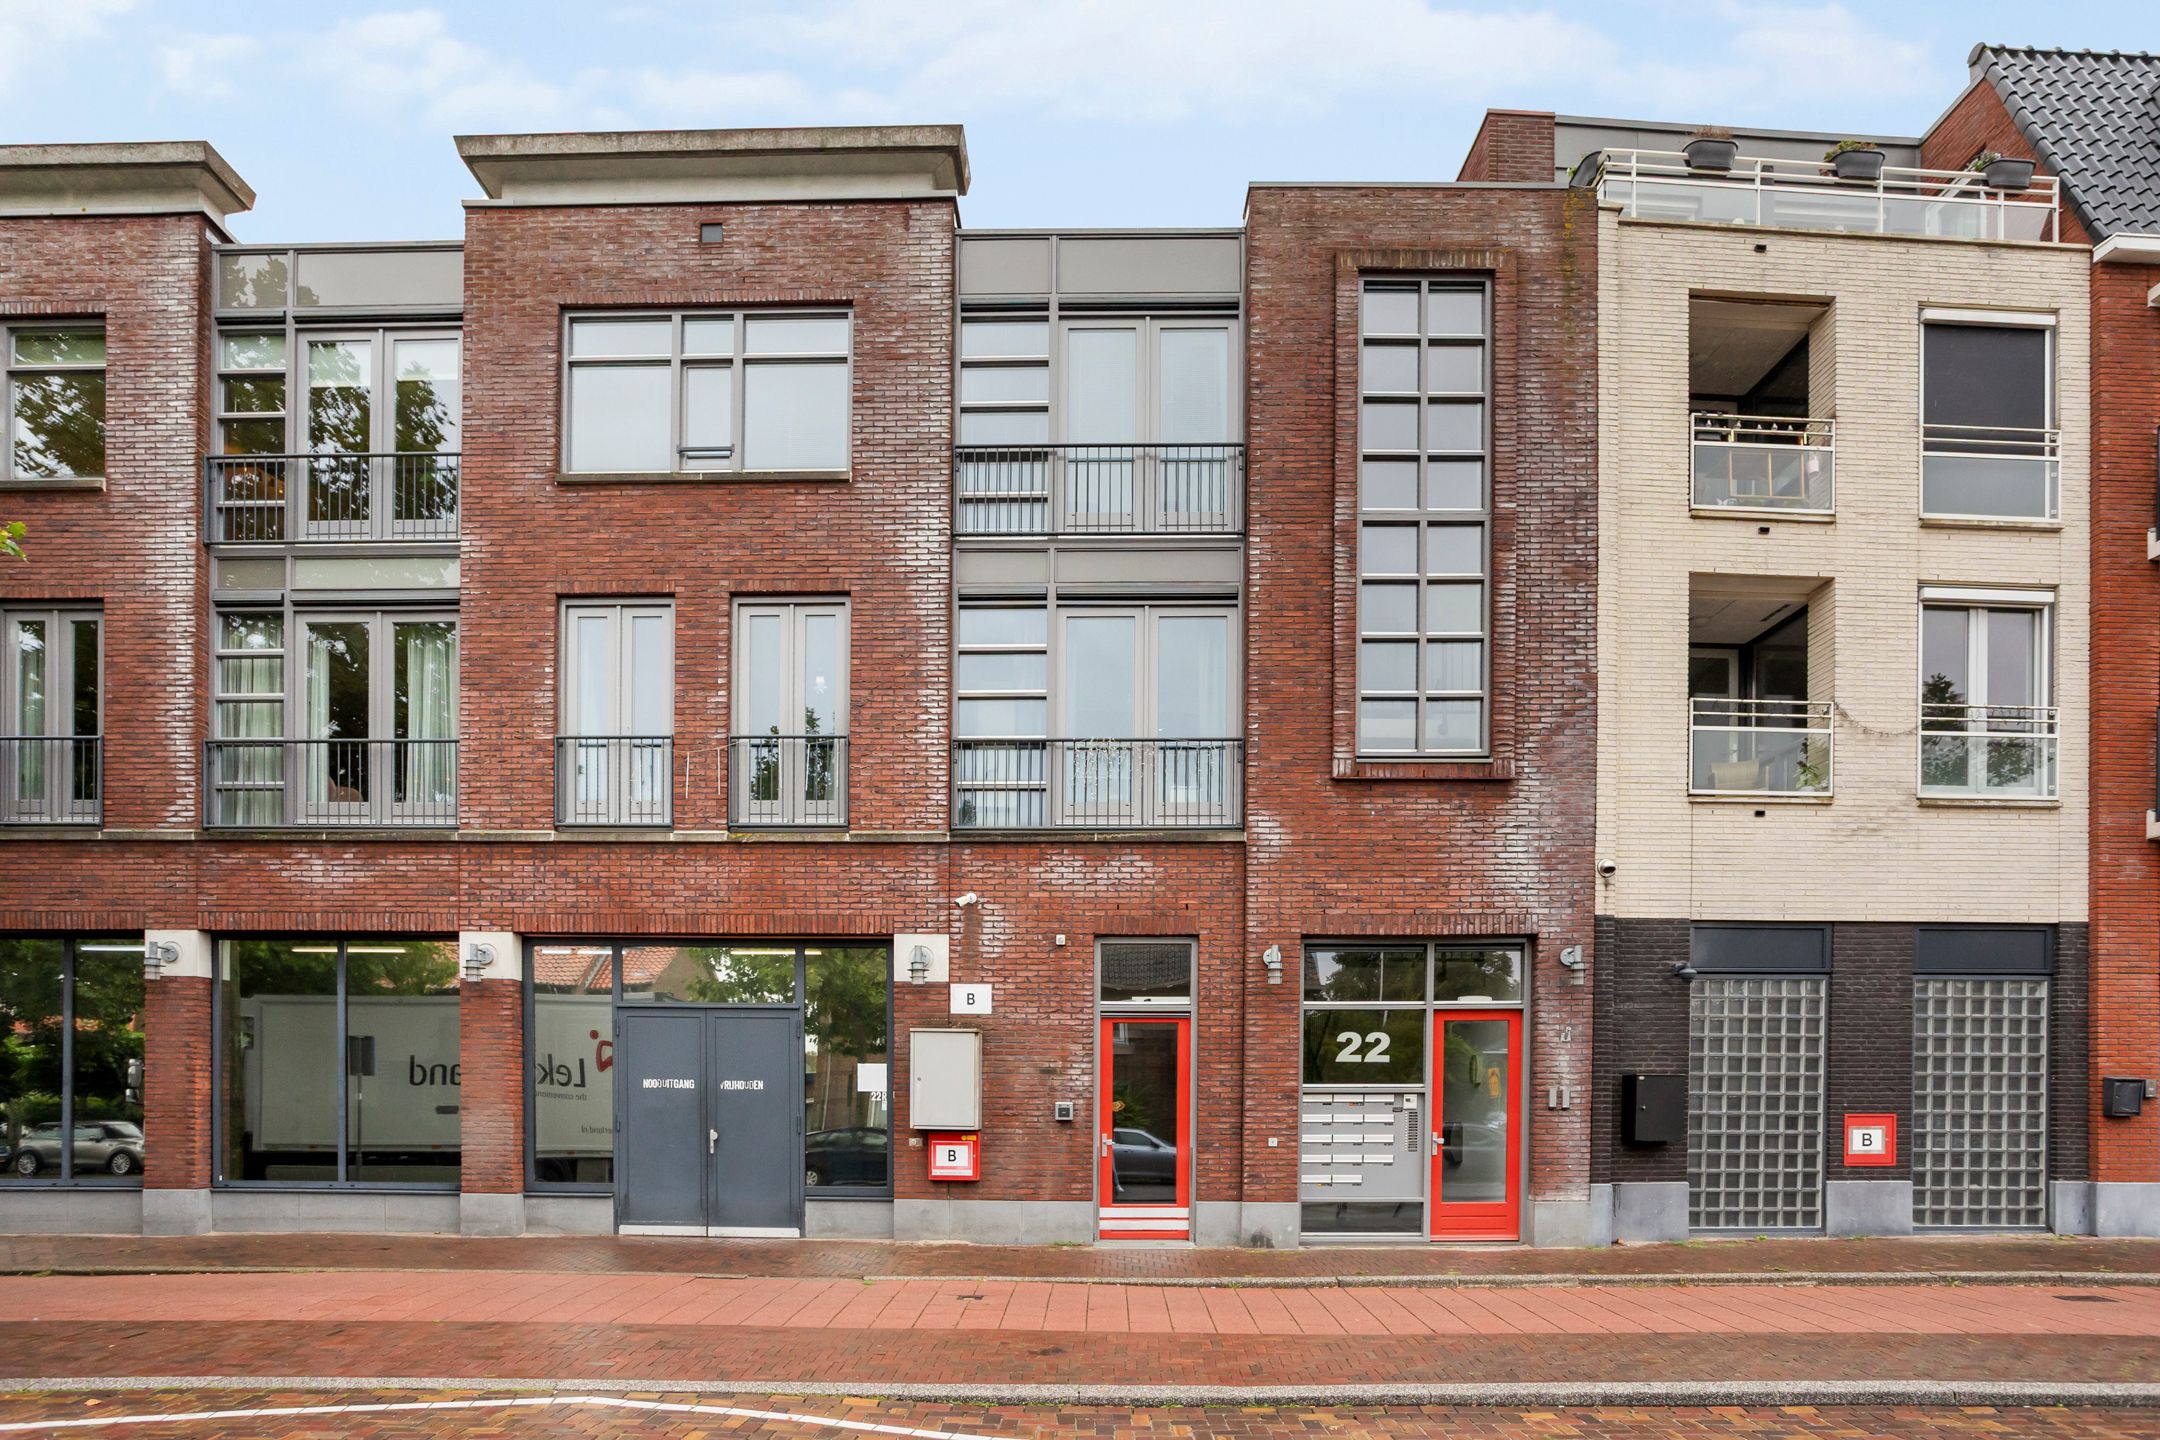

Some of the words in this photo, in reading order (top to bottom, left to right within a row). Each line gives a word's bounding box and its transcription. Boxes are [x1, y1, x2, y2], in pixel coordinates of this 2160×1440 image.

[967, 993, 975, 1005] B
[1335, 1031, 1391, 1063] 22
[642, 1078, 695, 1089] NOODUITGANG
[1862, 1133, 1873, 1147] B
[948, 1149, 957, 1162] B
